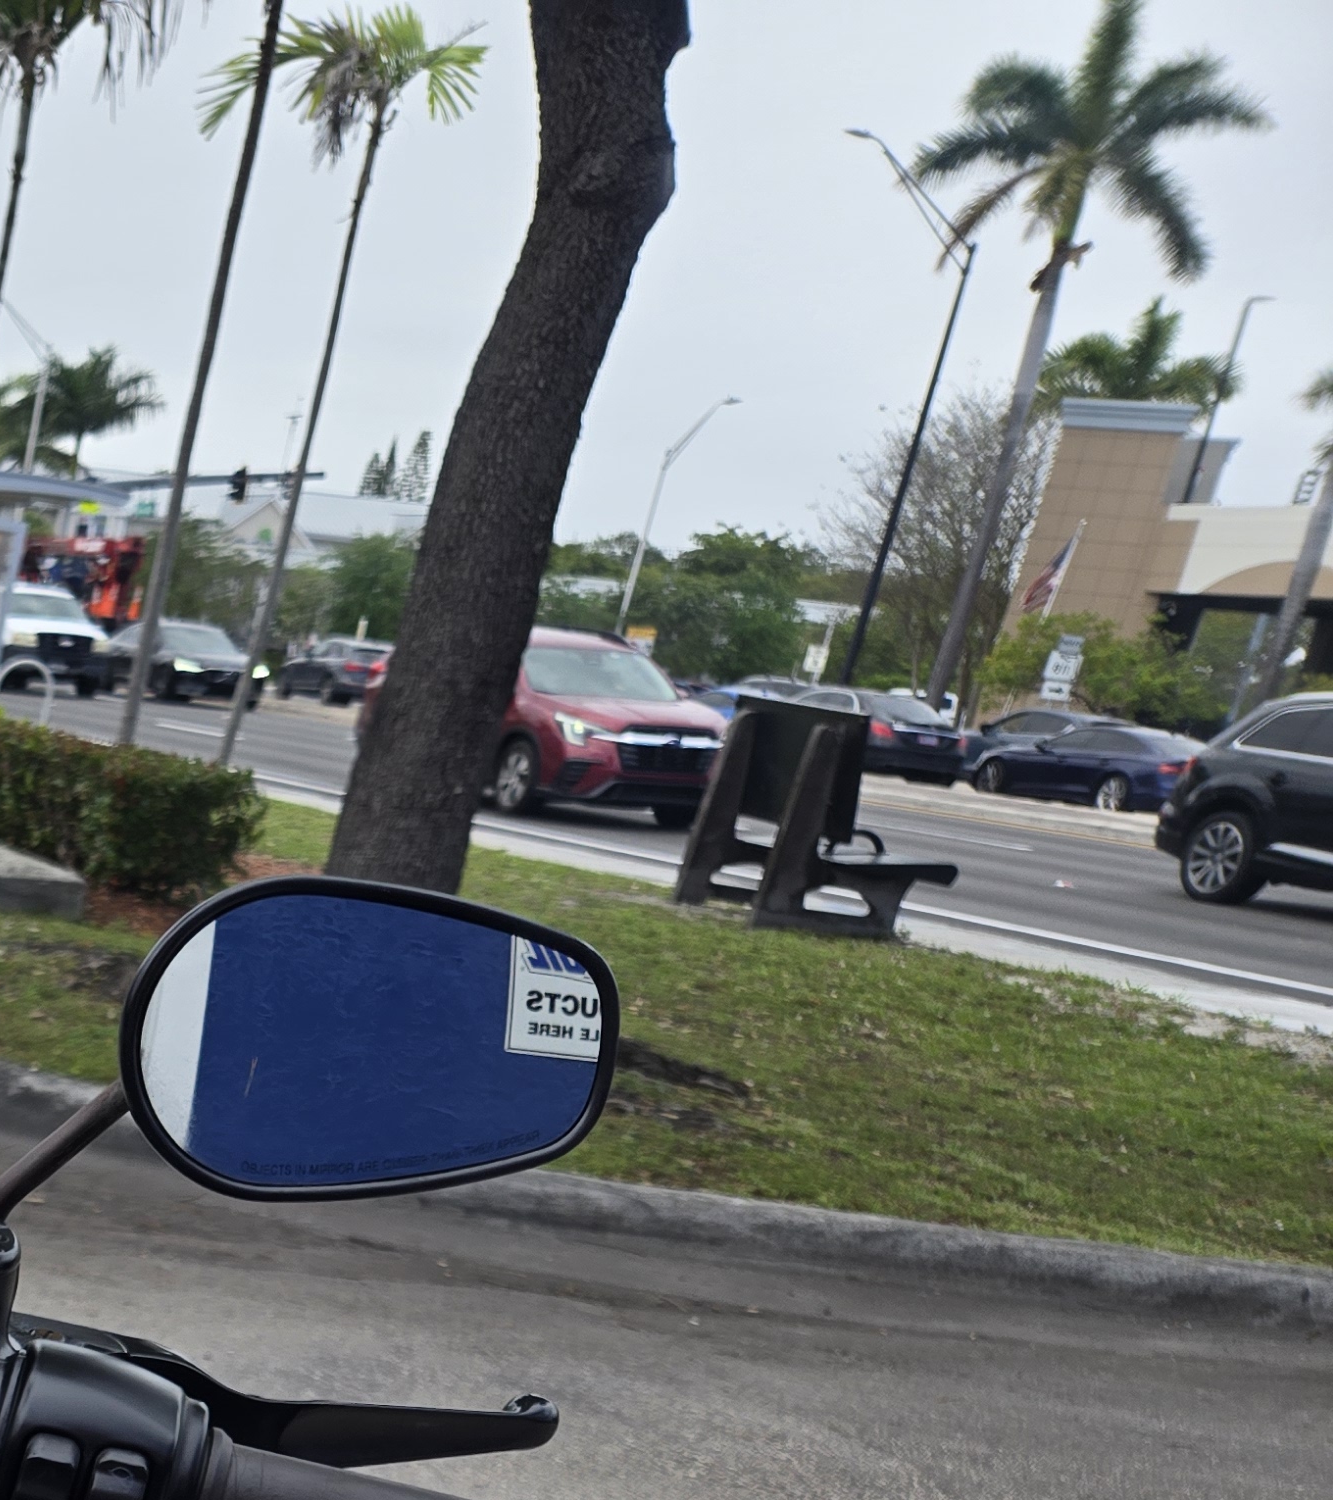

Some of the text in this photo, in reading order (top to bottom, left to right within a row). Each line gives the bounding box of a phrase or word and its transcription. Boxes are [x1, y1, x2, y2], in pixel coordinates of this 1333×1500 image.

[240, 1160, 292, 1176] OBJECTS
[295, 1164, 306, 1176] IN
[357, 1160, 380, 1173] ARE
